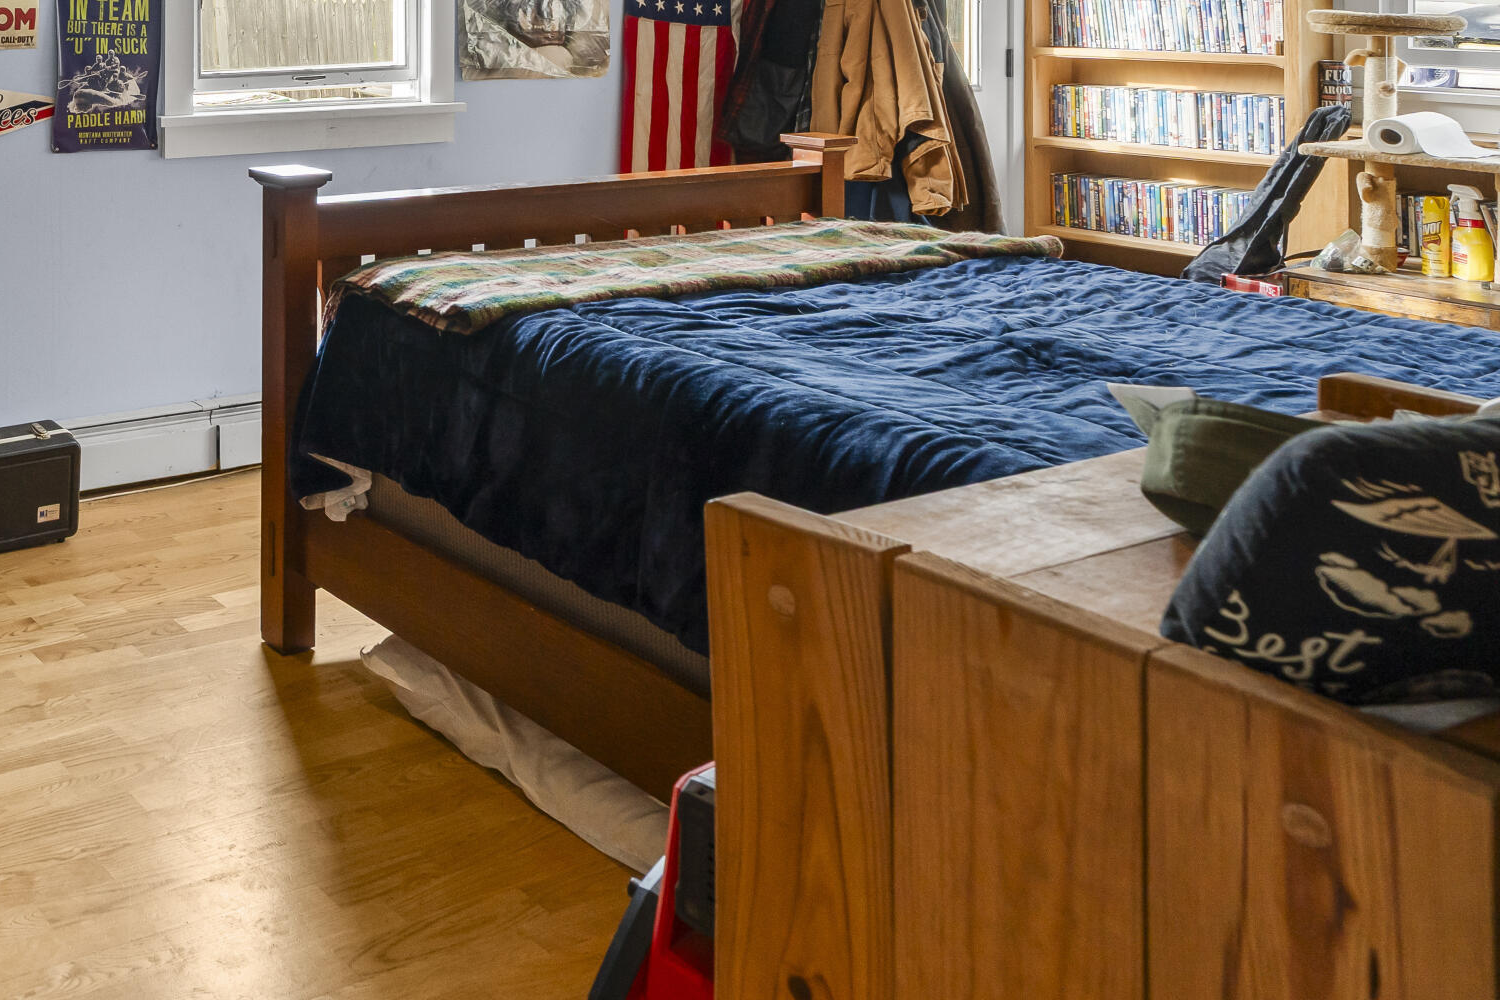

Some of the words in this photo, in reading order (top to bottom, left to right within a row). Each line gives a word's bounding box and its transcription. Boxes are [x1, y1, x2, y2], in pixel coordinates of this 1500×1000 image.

[67, 20, 88, 34] BUT
[91, 21, 123, 36] THERE
[126, 23, 136, 36] IS
[140, 24, 147, 37] A
[96, 37, 109, 55] IN
[114, 37, 148, 55] SUCK
[67, 112, 110, 129] PADDLE
